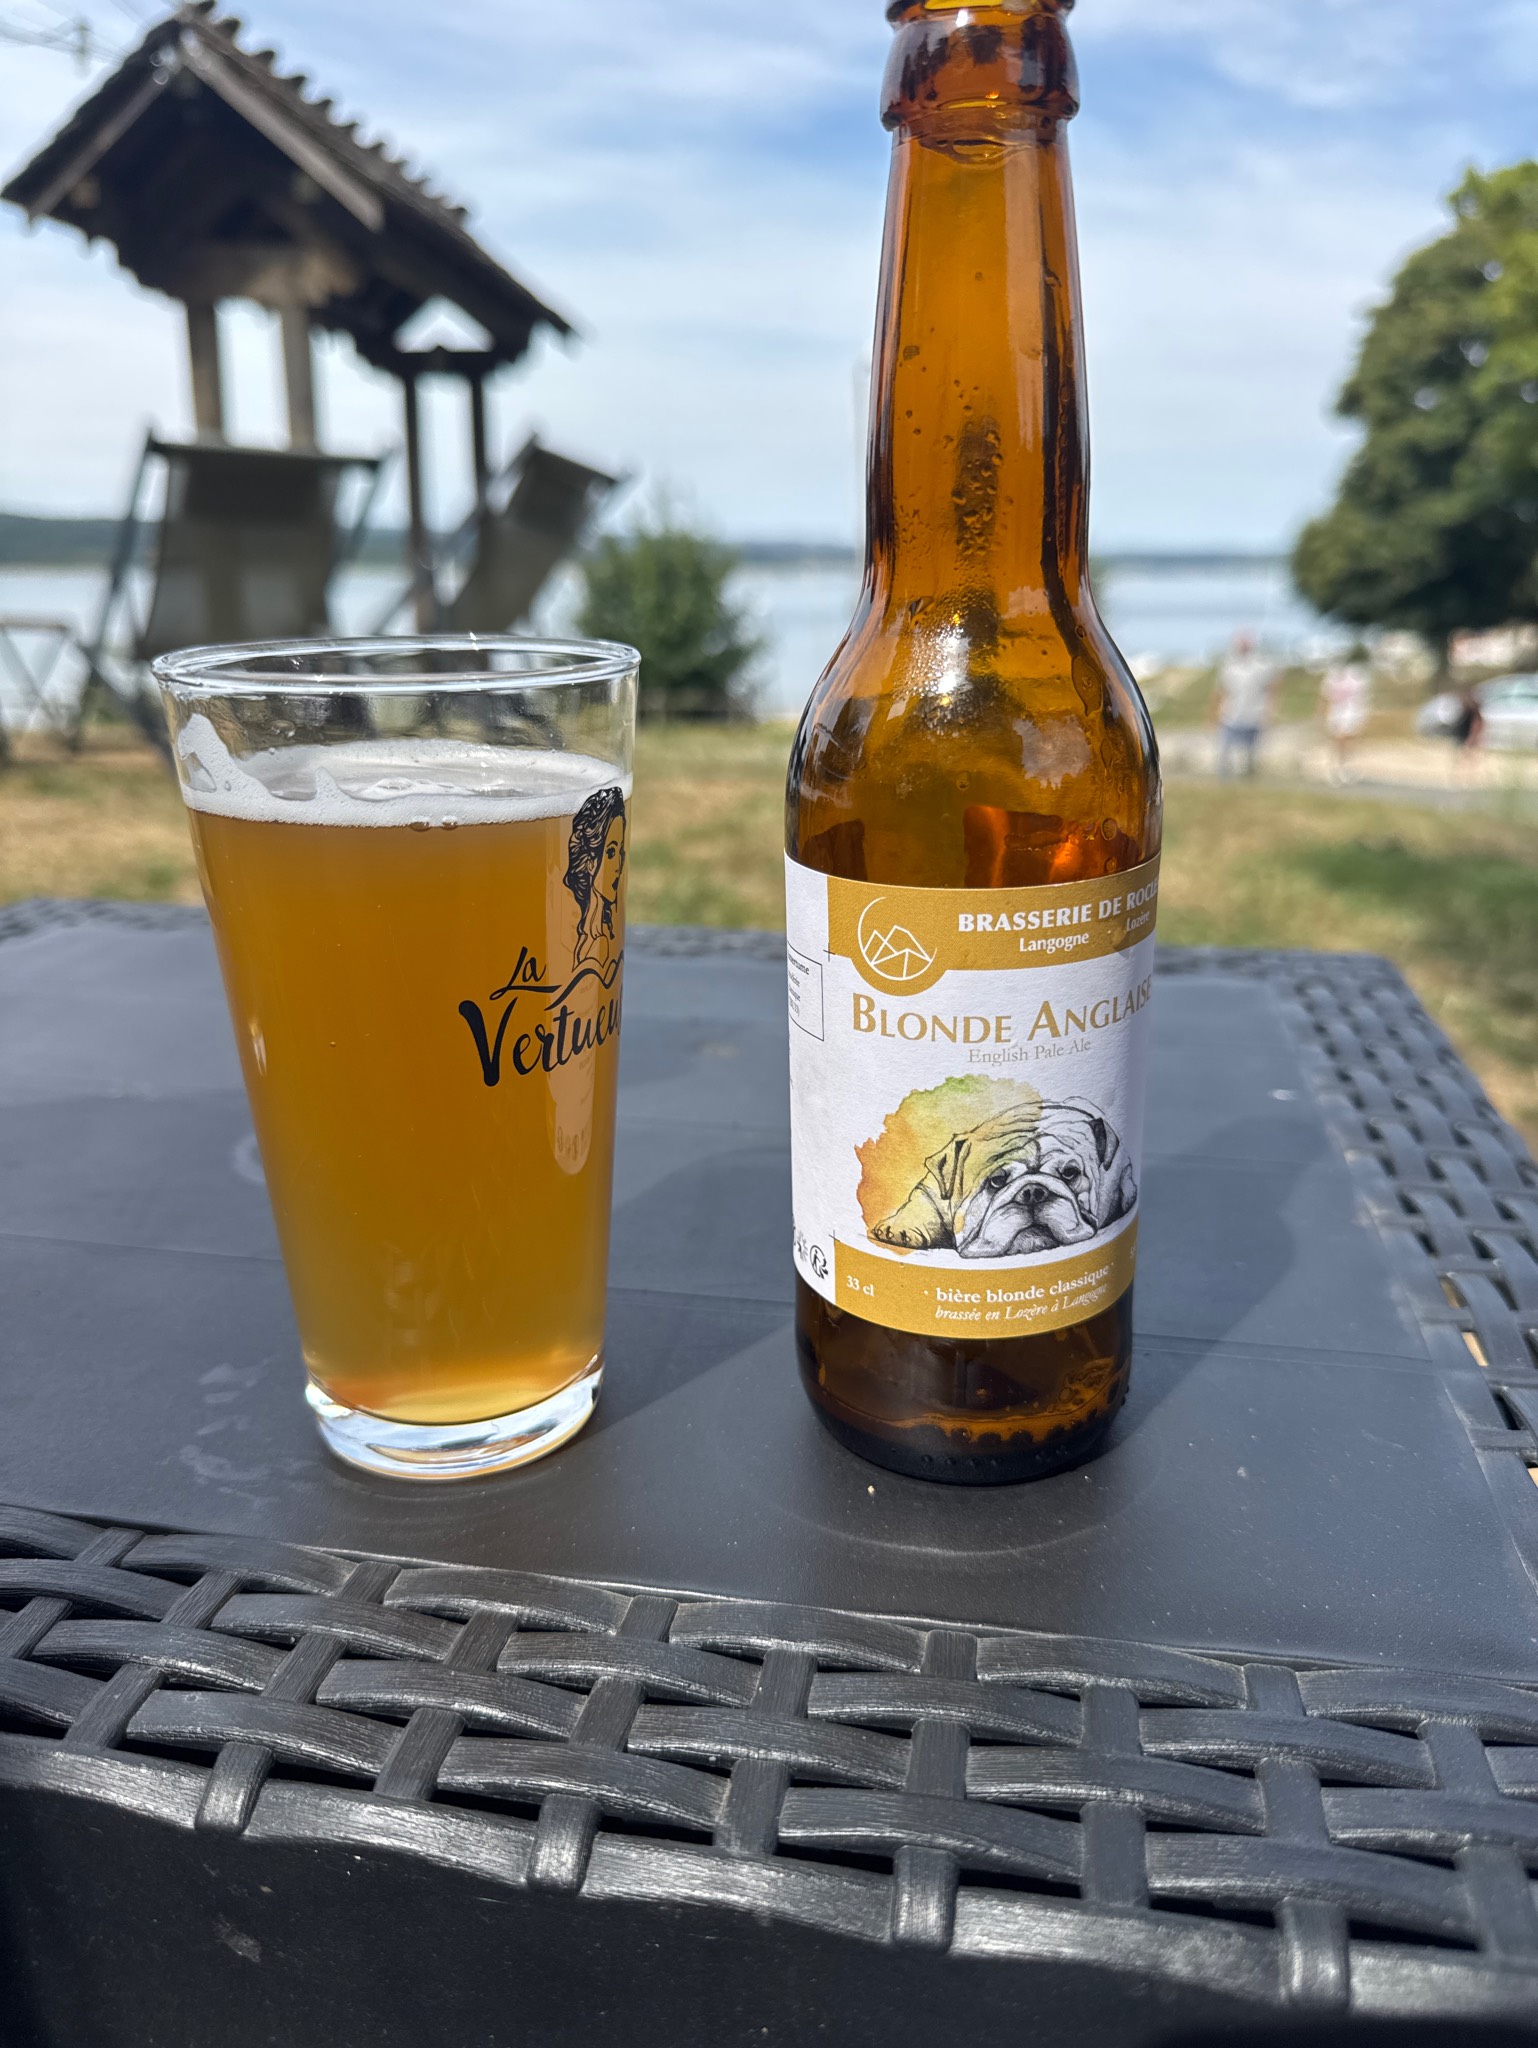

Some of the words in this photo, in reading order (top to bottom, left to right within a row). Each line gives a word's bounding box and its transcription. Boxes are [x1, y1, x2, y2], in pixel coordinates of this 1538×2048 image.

[958, 903, 1092, 933] BRASSERIE
[1098, 897, 1122, 920] DE
[1018, 931, 1090, 955] Langogne
[1126, 910, 1150, 933] Lozère
[489, 946, 562, 1000] La
[852, 992, 1012, 1044] BLONDE
[1028, 974, 1152, 1041] ANGLAISE
[967, 1049, 1027, 1066] English
[1034, 1046, 1065, 1060] Pale
[1068, 1038, 1092, 1054] Ale
[846, 1275, 860, 1291] 33
[862, 1284, 875, 1297] cl
[935, 1287, 981, 1304] bière
[986, 1286, 1045, 1304] blonde
[1049, 1265, 1110, 1297] classique
[934, 1305, 983, 1321] brassée
[985, 1310, 1000, 1321] en
[1004, 1303, 1048, 1322] Lozère
[1050, 1299, 1060, 1313] à
